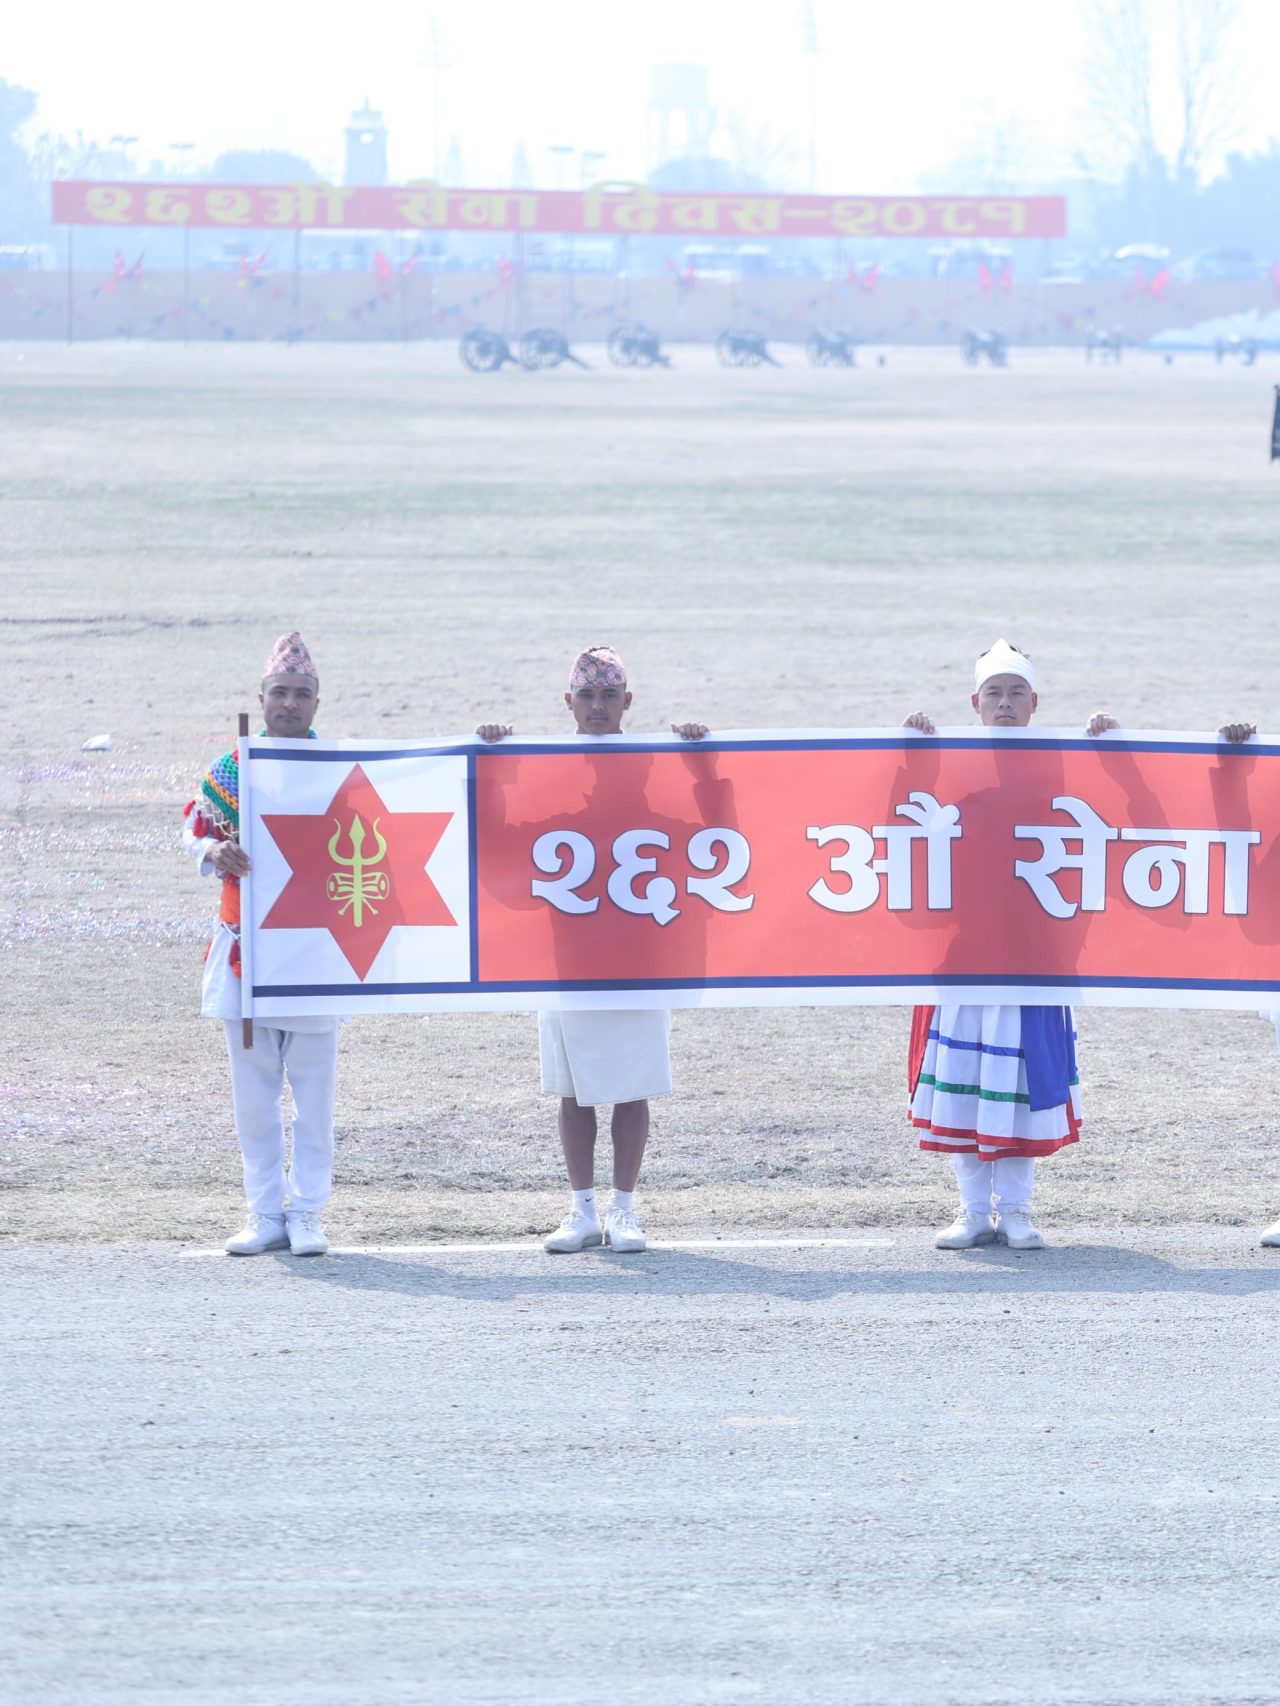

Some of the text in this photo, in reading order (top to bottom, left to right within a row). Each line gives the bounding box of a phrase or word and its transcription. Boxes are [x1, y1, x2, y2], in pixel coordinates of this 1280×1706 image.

[395, 179, 540, 228] सेना
[531, 827, 755, 926] २६२
[1014, 796, 1261, 919] सेना
